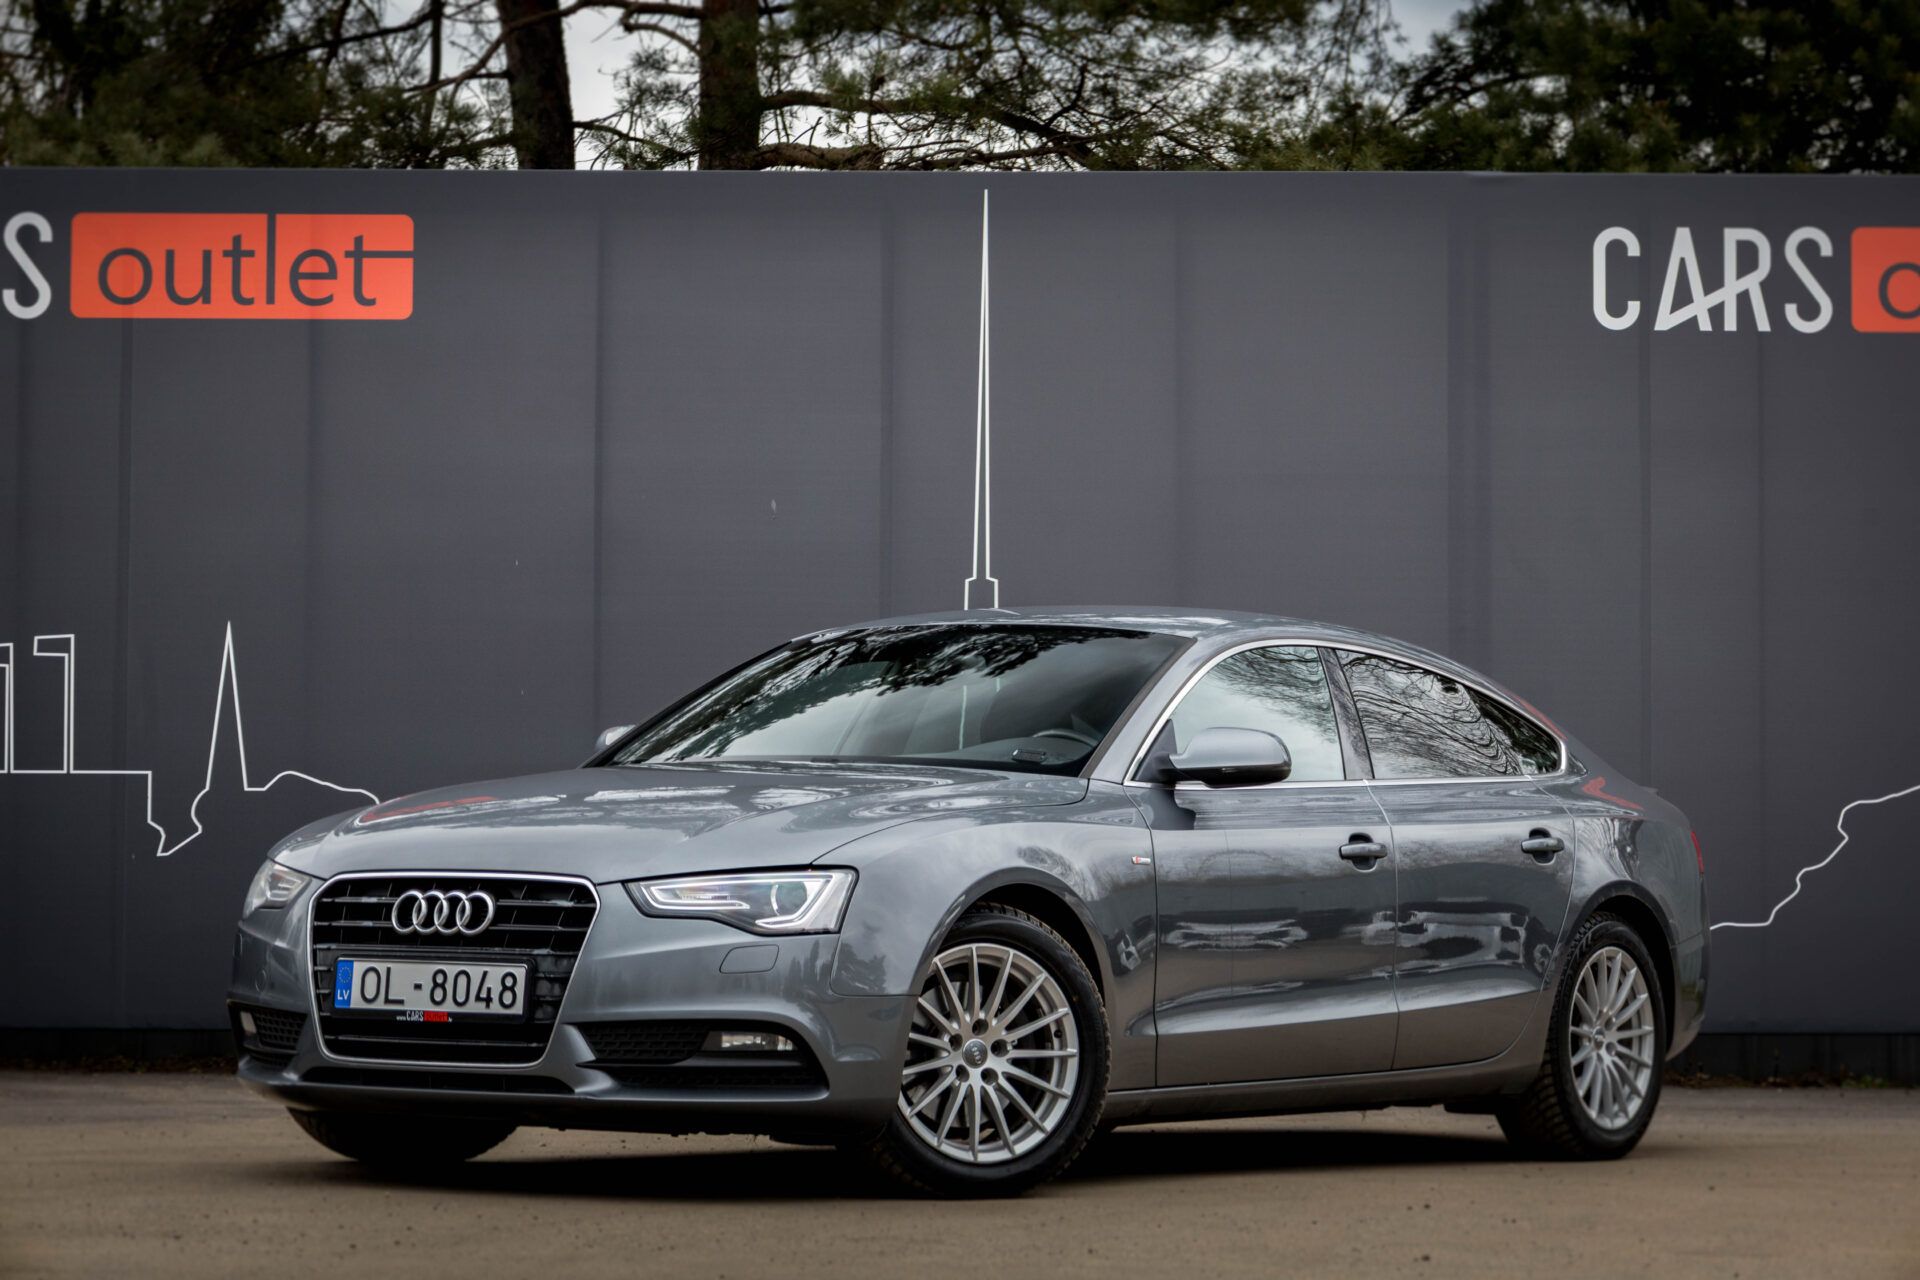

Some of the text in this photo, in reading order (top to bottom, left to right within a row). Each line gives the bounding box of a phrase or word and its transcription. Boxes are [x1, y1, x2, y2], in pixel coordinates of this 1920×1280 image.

[97, 213, 413, 306] outlet
[1593, 226, 1833, 334] CARS
[337, 988, 350, 1000] LV
[360, 966, 518, 1009] OL-8048
